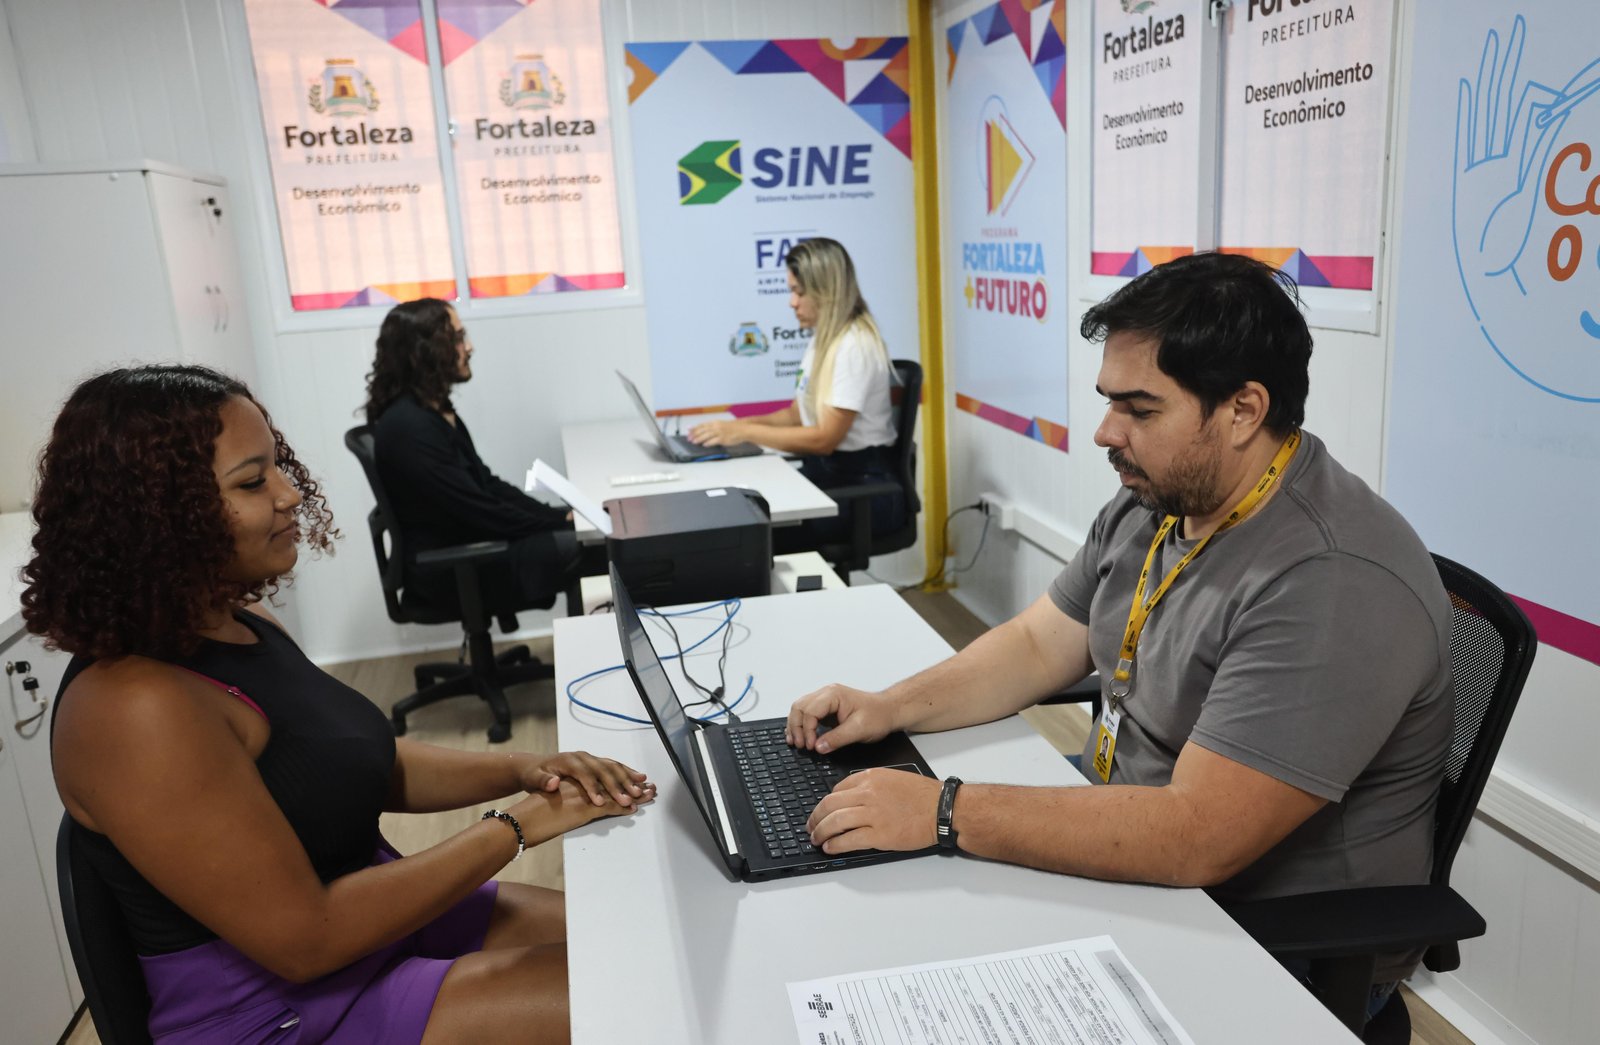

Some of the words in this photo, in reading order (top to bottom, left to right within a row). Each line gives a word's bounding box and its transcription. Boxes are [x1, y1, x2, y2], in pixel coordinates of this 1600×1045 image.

[1103, 13, 1185, 63] Fortaleza
[1262, 5, 1355, 46] PREFEITURA
[1113, 56, 1172, 83] PREFEITURA
[1244, 61, 1373, 104] Desenvolvimento
[1103, 100, 1184, 130] Desenvolvimento
[1263, 99, 1346, 129] Econômico
[284, 123, 414, 148] Fortaleza
[474, 116, 597, 141] Fortaleza
[1115, 128, 1168, 150] Econômico
[306, 152, 399, 166] PREFEITURA
[494, 144, 581, 157] PREFEITURA
[292, 182, 422, 201] Desenvolvimento
[480, 173, 602, 191] Desenvolvimento
[317, 199, 401, 217] Econômico
[503, 189, 583, 206] Econômico
[756, 238, 812, 269] FA
[962, 242, 1045, 275] FORTALEZA
[758, 278, 786, 286] AMPA
[812, 993, 828, 1018] SEBRAE
